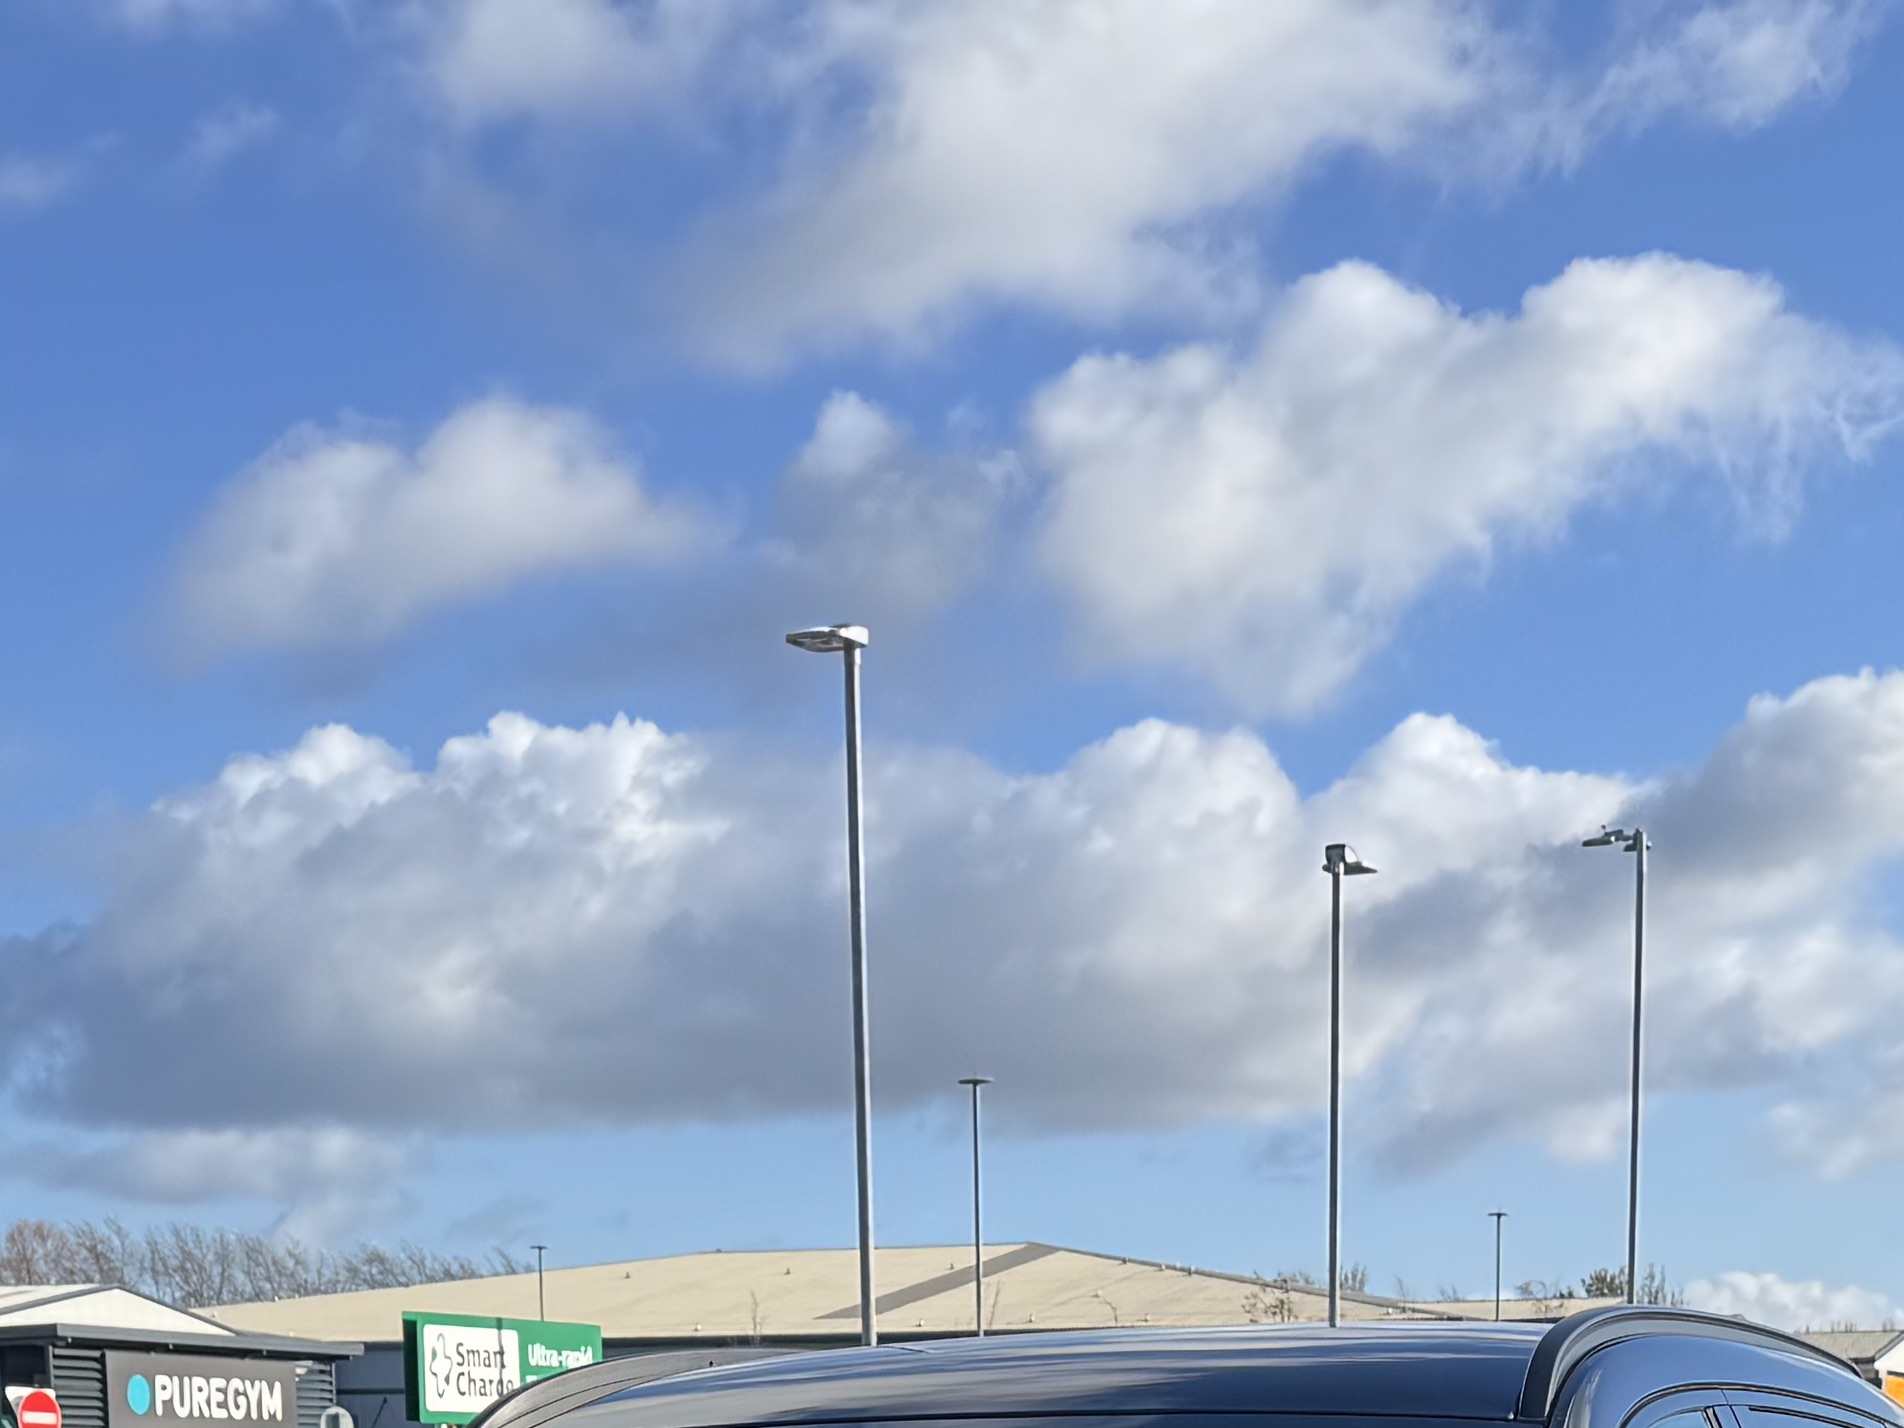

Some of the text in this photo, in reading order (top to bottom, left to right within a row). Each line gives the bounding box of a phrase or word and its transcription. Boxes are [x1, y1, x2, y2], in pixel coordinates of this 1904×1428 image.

[456, 1342, 506, 1369] Smart
[528, 1343, 593, 1368] Ultra-rapid
[154, 1374, 282, 1422] PUREGYM
